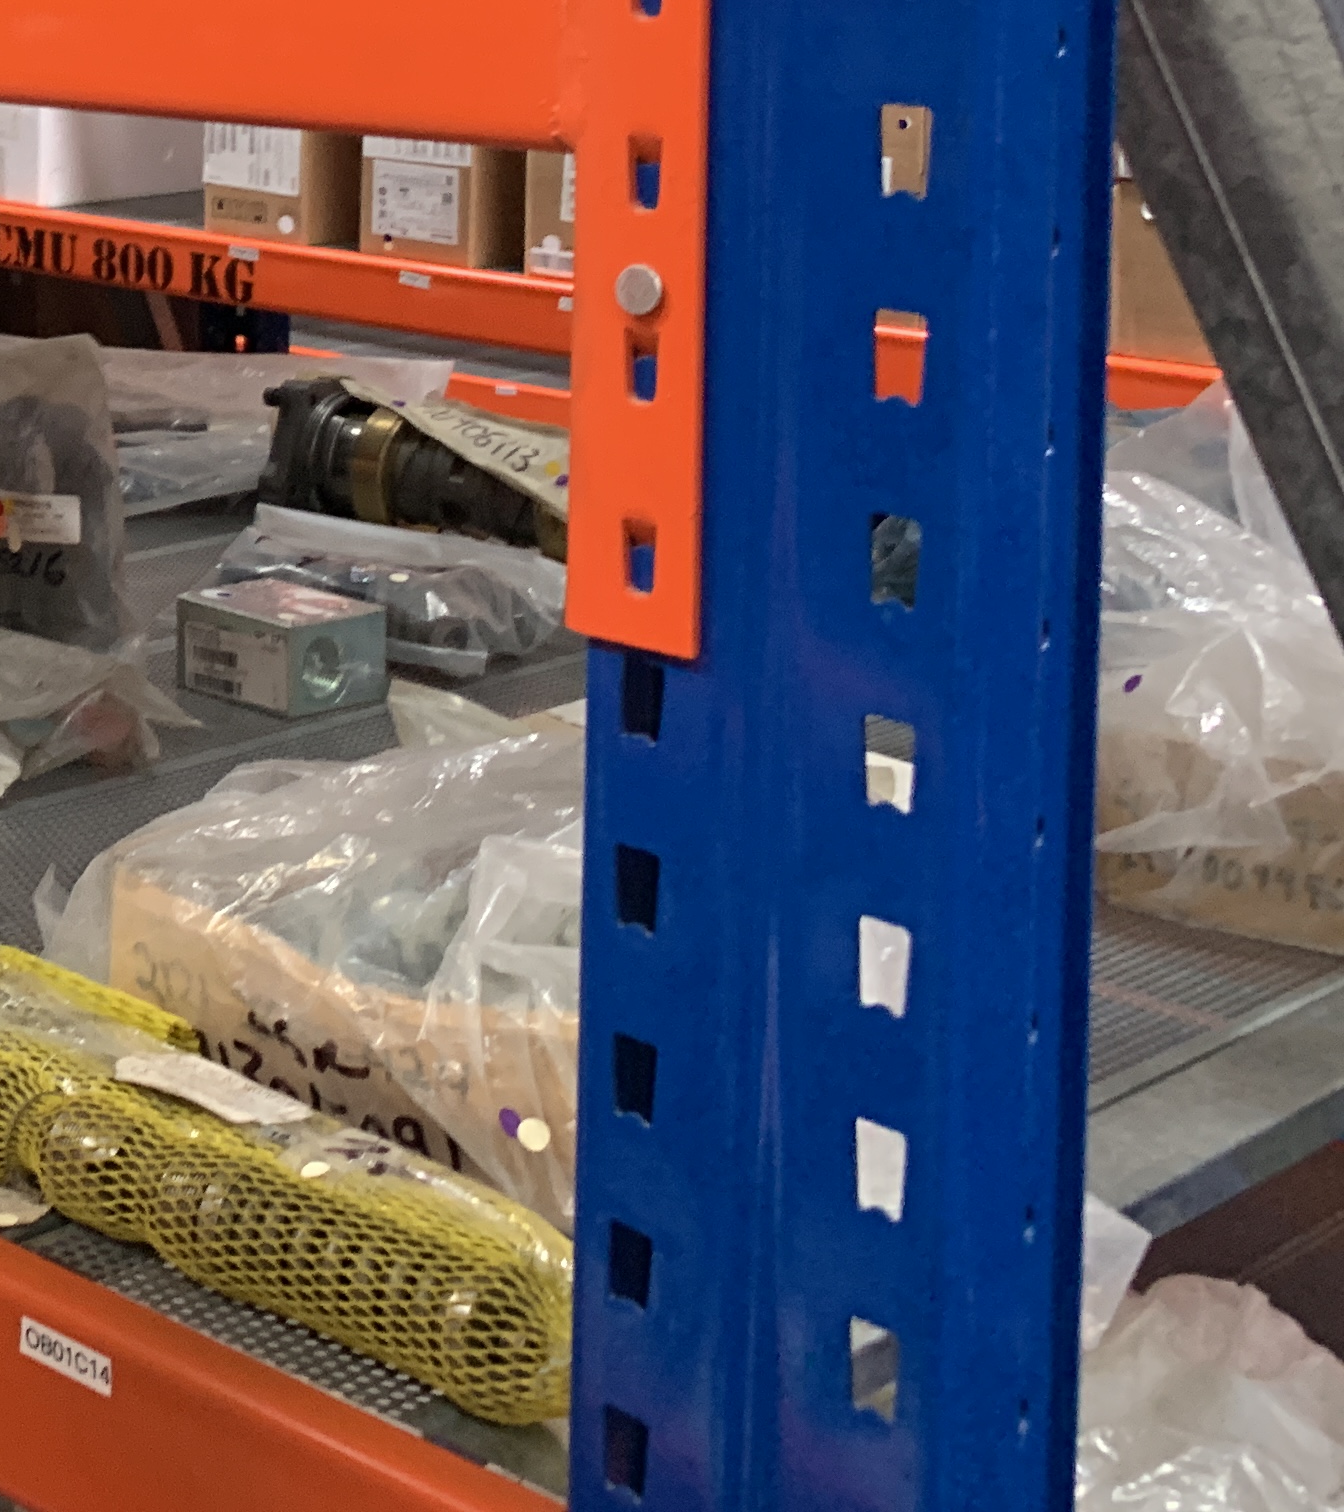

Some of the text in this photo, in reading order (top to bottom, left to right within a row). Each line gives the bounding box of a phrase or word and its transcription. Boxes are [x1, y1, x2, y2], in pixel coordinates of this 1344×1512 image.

[92, 237, 175, 291] 800
[187, 250, 256, 304] KG
[25, 1325, 110, 1386] OB01C14
